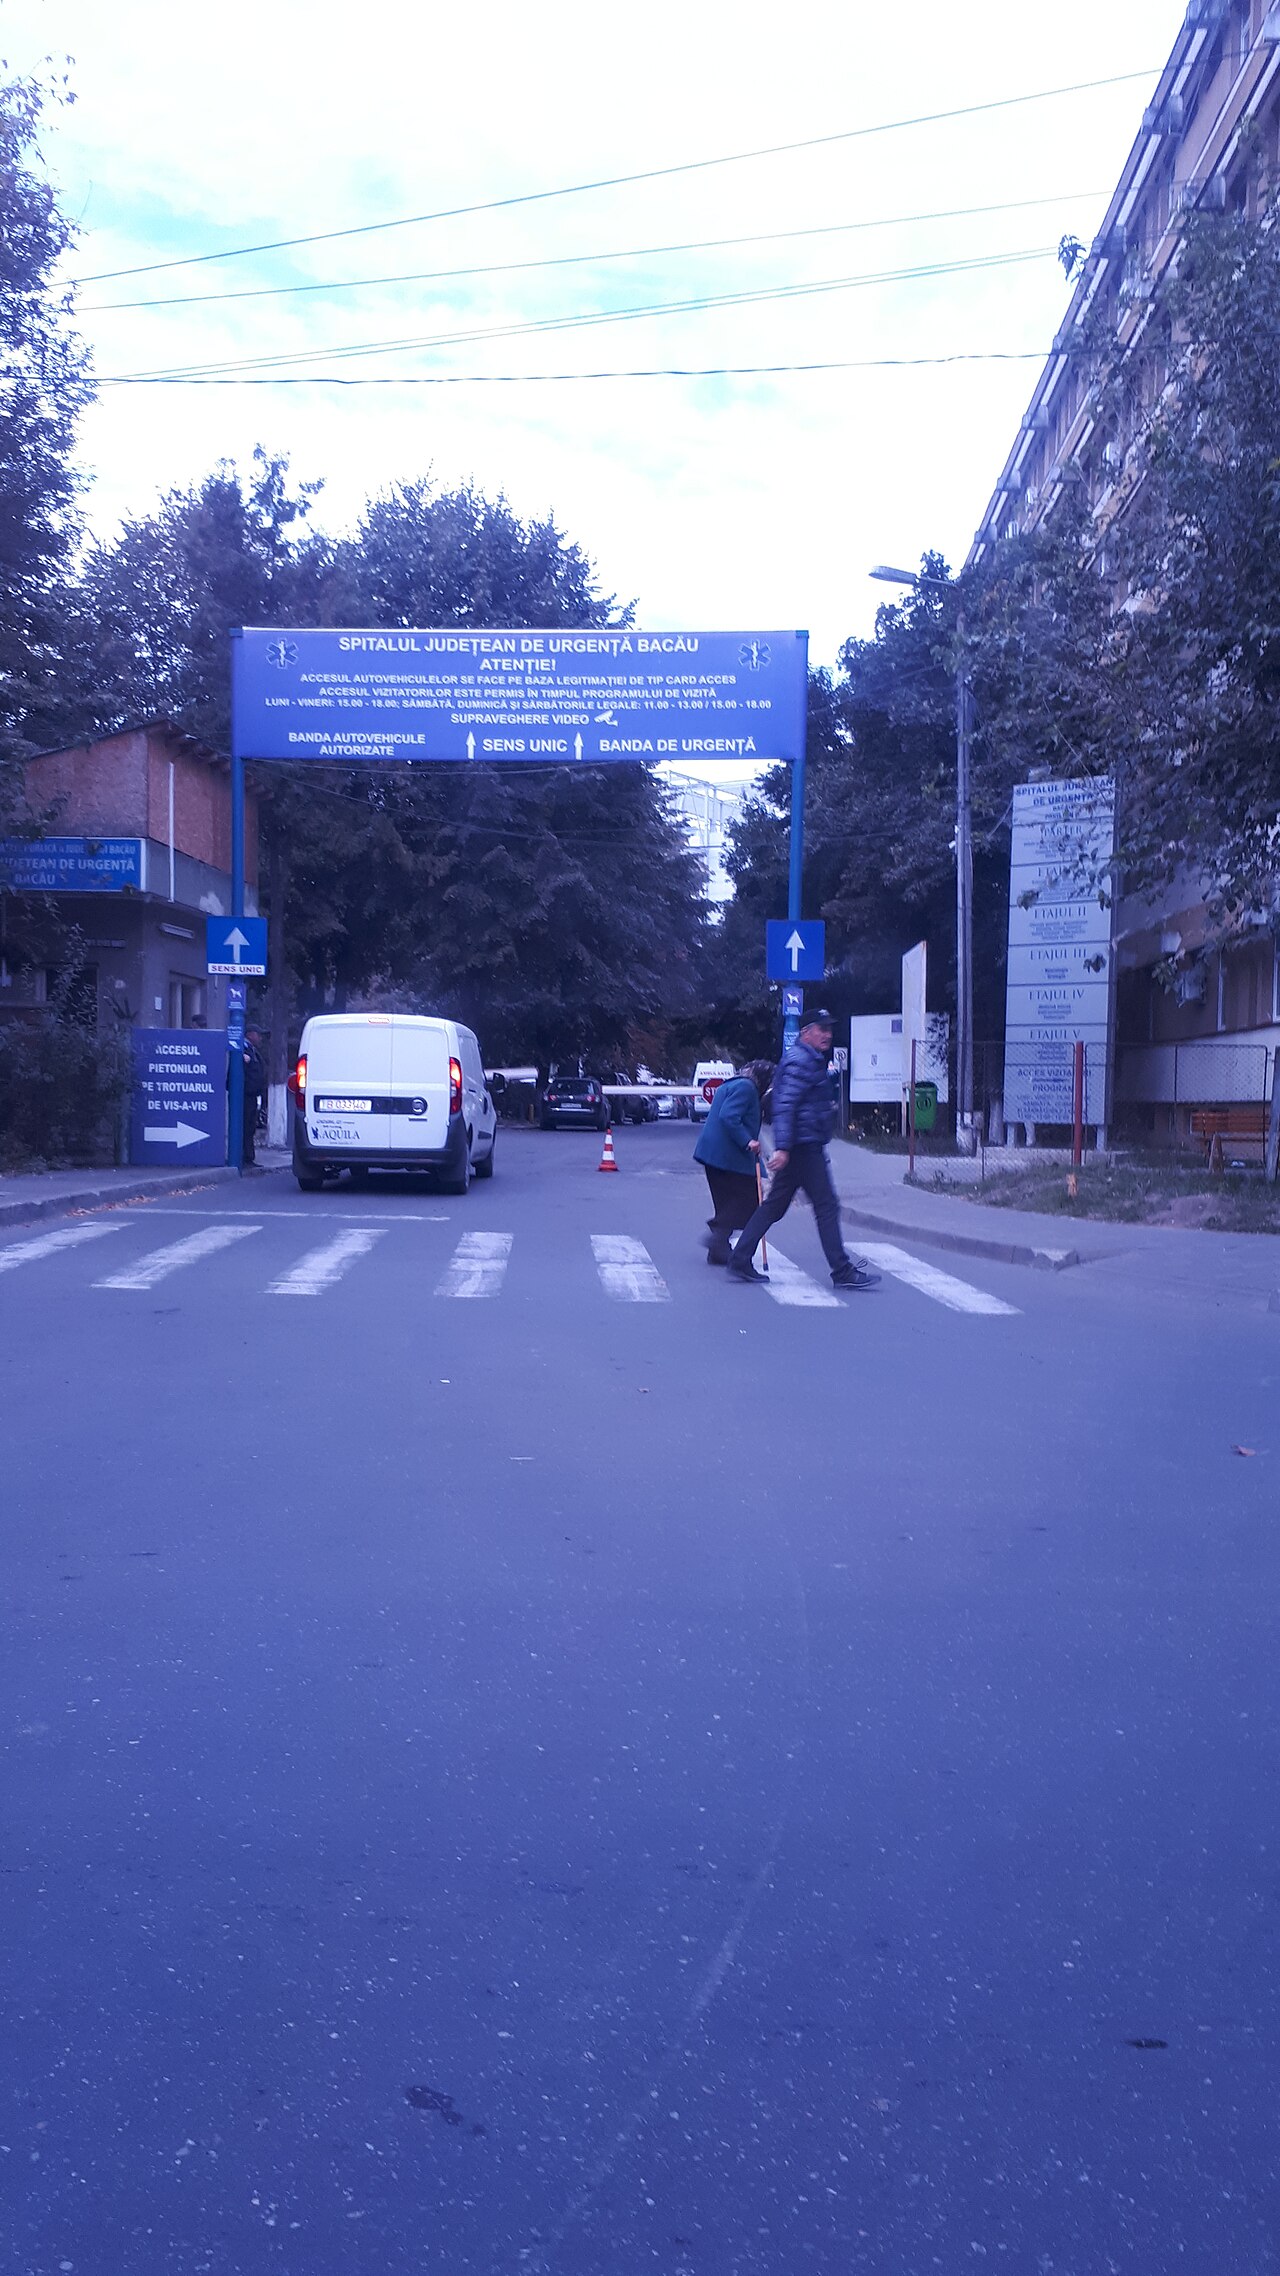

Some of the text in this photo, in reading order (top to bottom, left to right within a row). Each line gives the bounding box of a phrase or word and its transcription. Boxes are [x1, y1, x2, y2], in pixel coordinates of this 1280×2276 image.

[339, 635, 699, 658] SPITALUL JUDEȚEAN DE URGENȚĂ BACĂU
[480, 659, 556, 675] ATENȚIE!
[300, 674, 352, 683] ACCESUL
[353, 674, 458, 684] AUTOVEHICULELOR
[460, 675, 475, 684] SE
[477, 675, 505, 685] FACE
[507, 676, 522, 685] PE
[525, 676, 554, 685] BAZA
[629, 676, 644, 685] DE
[647, 675, 664, 685] TIP
[666, 675, 697, 685] CARD
[698, 675, 736, 684] ACCES
[319, 687, 717, 698] ACCESUL VIZITATORILOR ESTE PERMIS ÎN TIMPUL PROGRAMULUI DE VIZITĂ
[265, 698, 290, 707] LUNI
[297, 698, 335, 707] VINERI:
[337, 699, 363, 708] 15.00
[457, 699, 508, 709] DUMINICĂ
[522, 699, 595, 710] SĂRBĂTORILE
[596, 701, 641, 710] LEGALE:
[644, 701, 669, 710] 11.00
[677, 700, 703, 710] 13.00
[711, 700, 737, 709] 15.00
[746, 700, 772, 709] 18.00
[451, 713, 590, 725] SUPRAVEGHERE VIDEO
[288, 732, 426, 744] BANDA AUTOVEHICULE
[320, 745, 395, 756] AUTORIZATE
[482, 739, 568, 752] SENS UNIC
[599, 739, 653, 752] BANDA
[657, 739, 678, 752] DE
[1016, 785, 1058, 796] SPITALUL
[60, 859, 75, 869] DE
[1034, 907, 1073, 919] ETAJUL
[1030, 948, 1087, 960] ETAJUL III
[211, 965, 262, 974] SENS UNIC
[1029, 989, 1084, 1001] ETAJUL IV
[1030, 1030, 1081, 1040] ETAJUL V
[155, 1045, 200, 1055] ACCESUL
[148, 1063, 207, 1074] PIETONILOR
[156, 1082, 214, 1093] TROTUARUL
[148, 1100, 208, 1111] DE VIS-A-VIS
[322, 1130, 360, 1140] AQUILA
